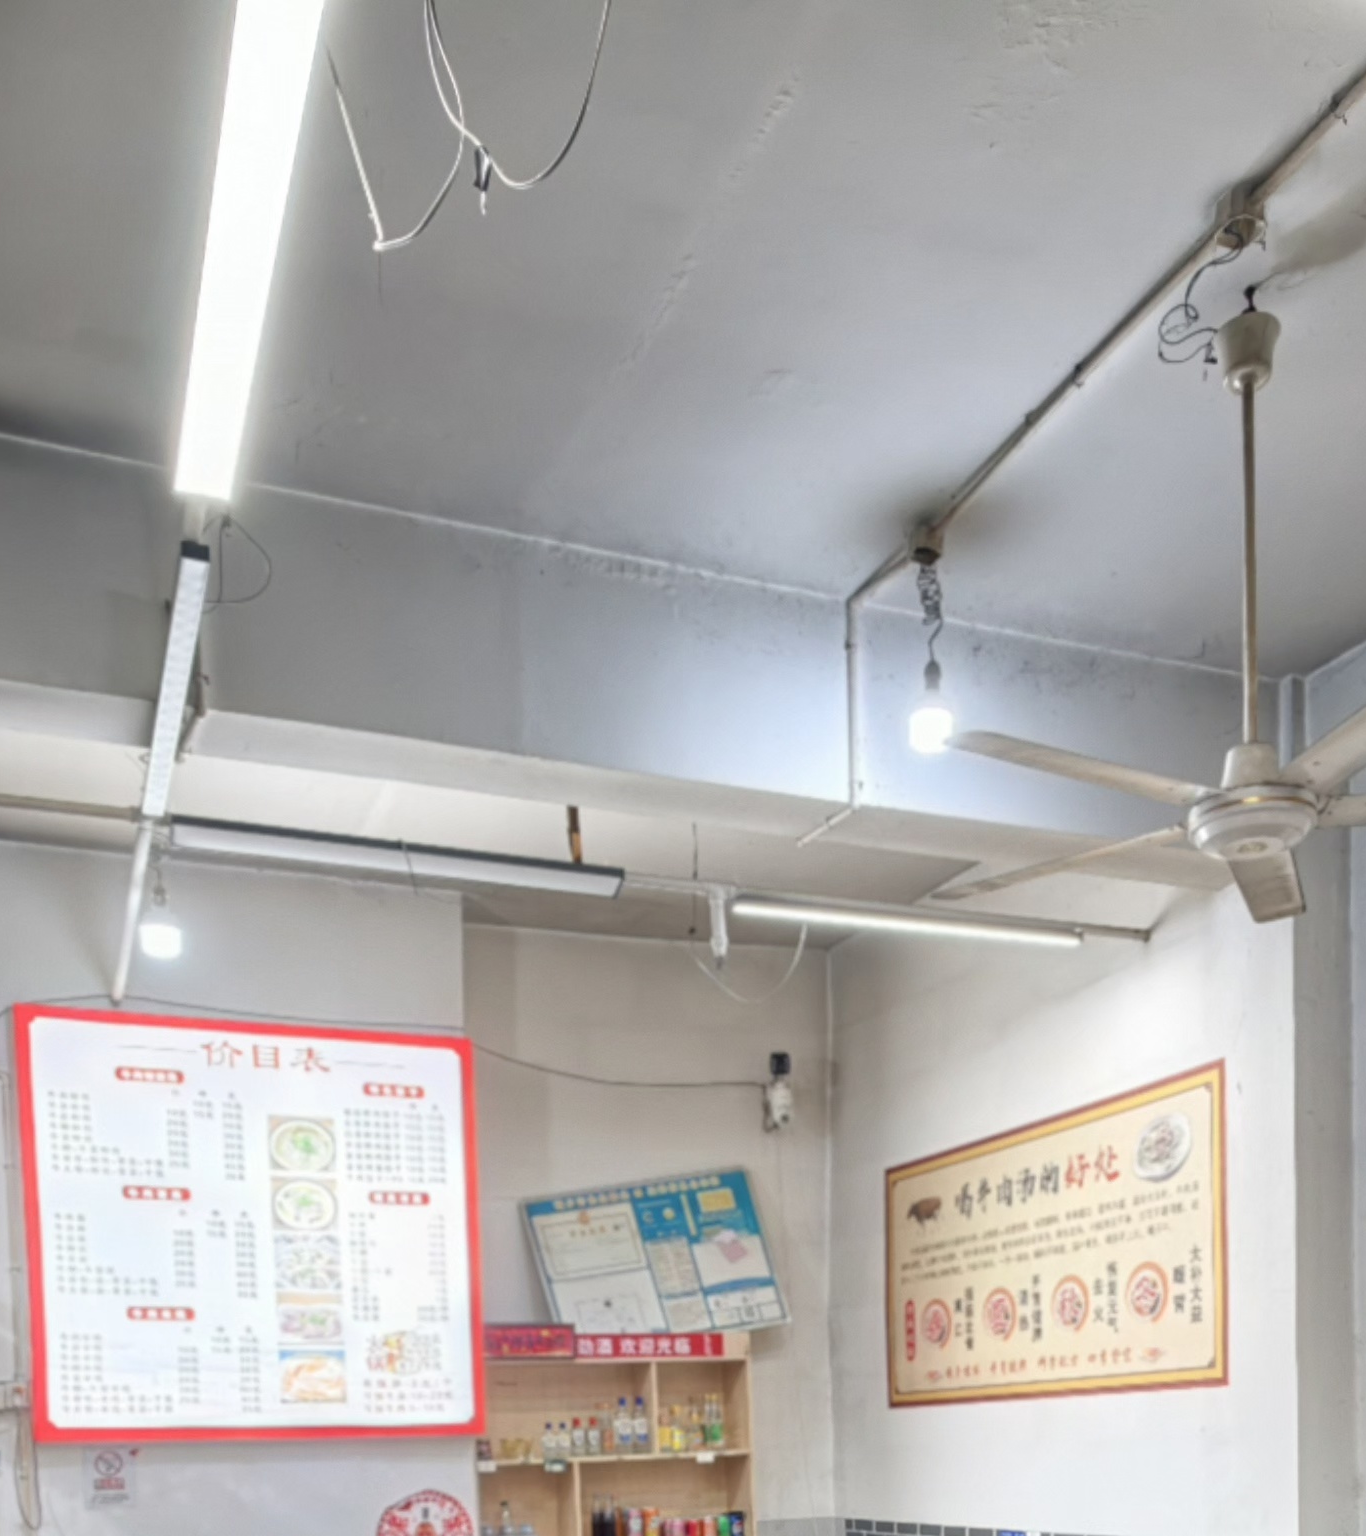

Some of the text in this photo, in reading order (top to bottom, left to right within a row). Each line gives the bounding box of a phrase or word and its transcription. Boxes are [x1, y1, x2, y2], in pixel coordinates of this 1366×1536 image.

[200, 1040, 332, 1074] 价目表
[954, 1145, 1120, 1221] 喝牛肉汤的好处
